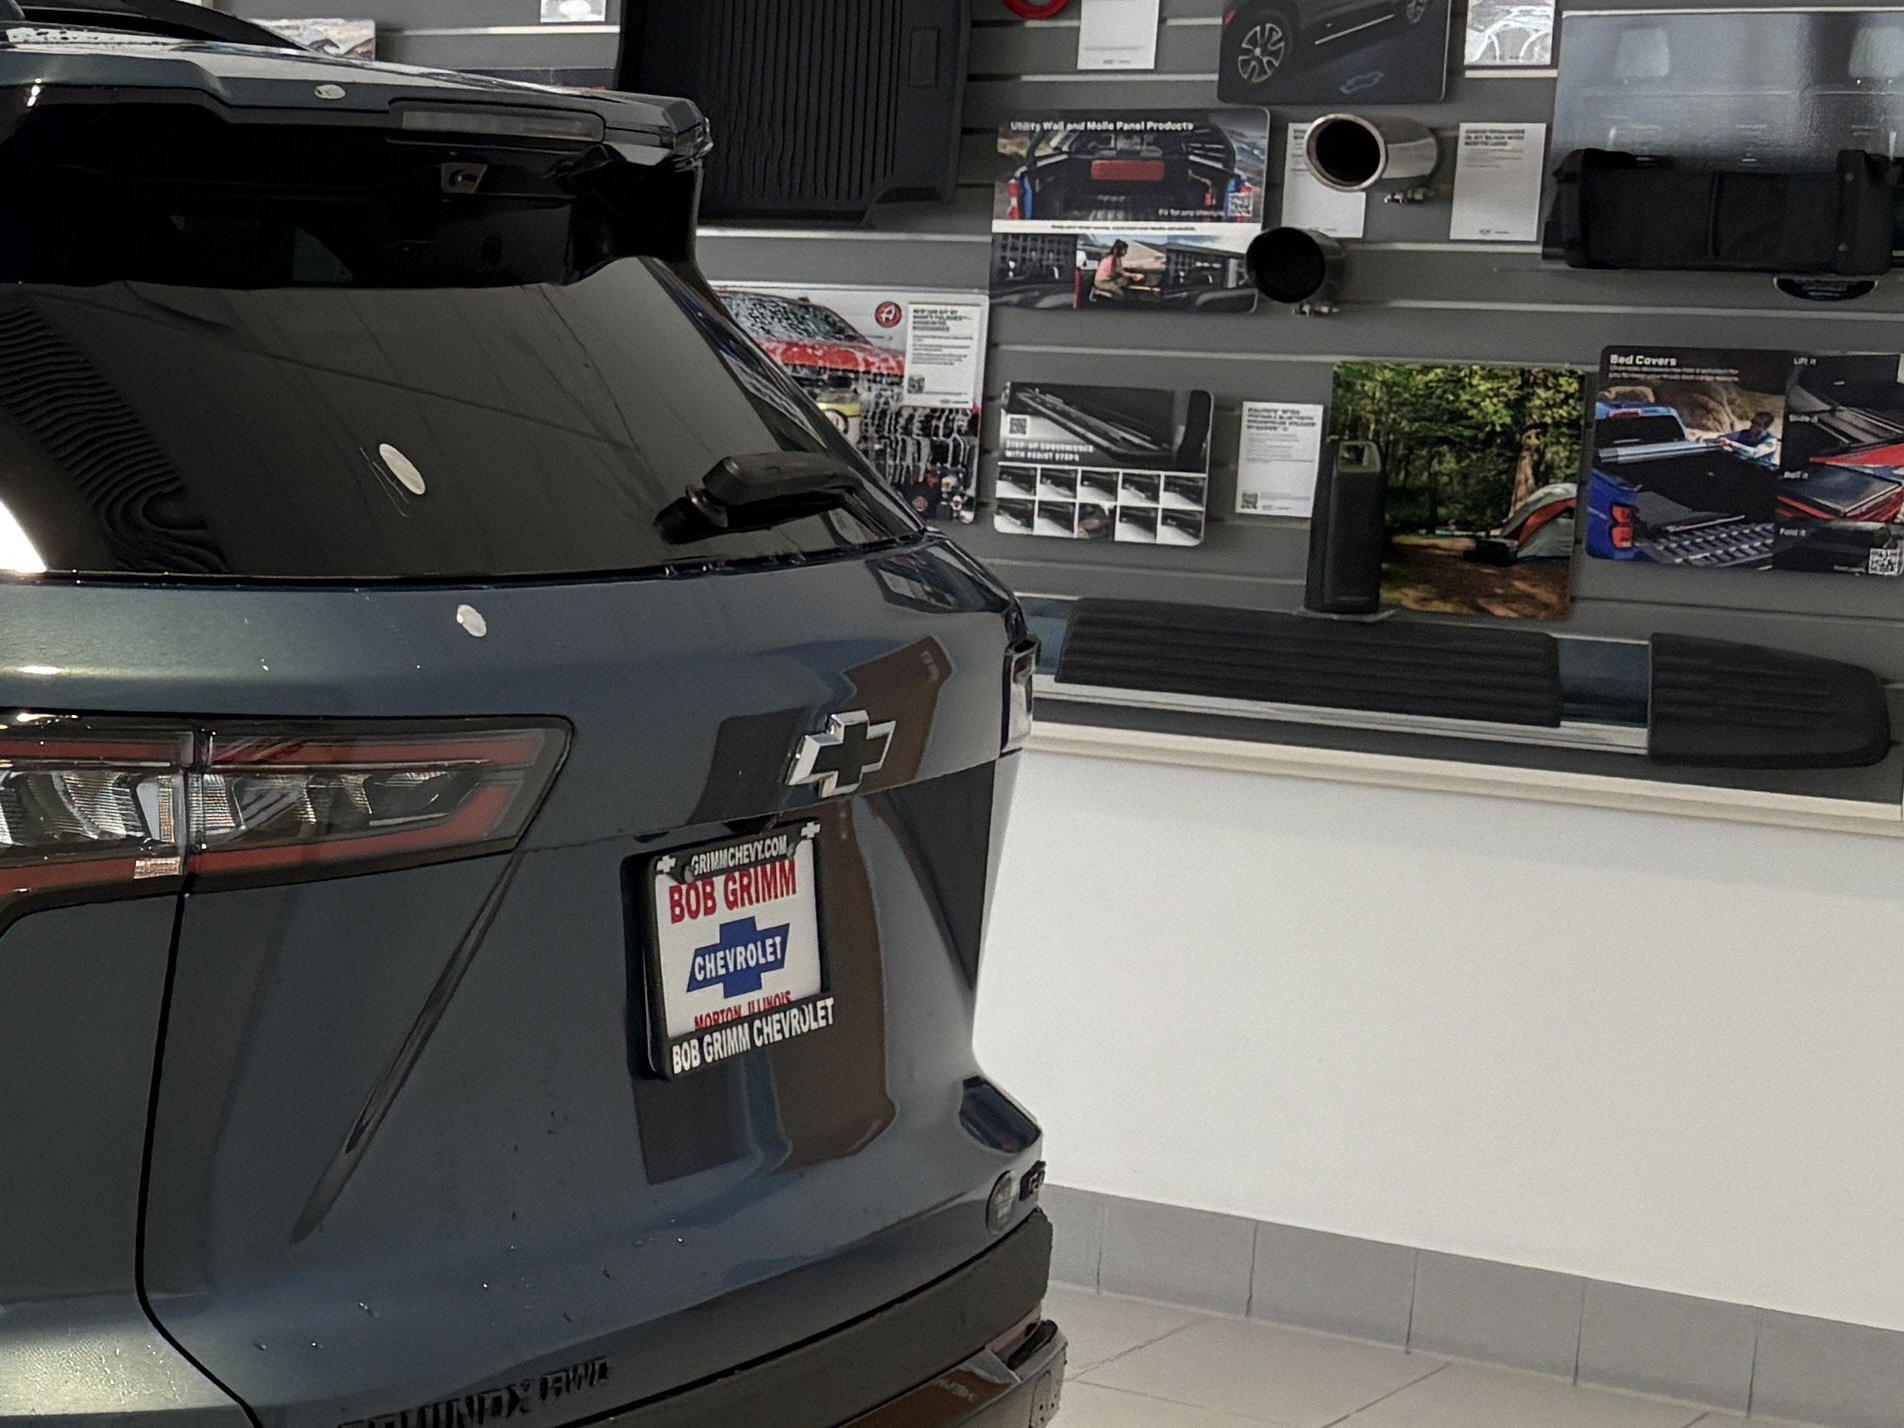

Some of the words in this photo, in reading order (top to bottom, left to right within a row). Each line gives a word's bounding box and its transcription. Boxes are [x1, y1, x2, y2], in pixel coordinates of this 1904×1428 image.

[1010, 121, 1040, 133] Utility
[1042, 121, 1064, 131] Wall
[1066, 121, 1085, 131] and
[1087, 120, 1114, 130] Molle
[1116, 121, 1144, 130] Panel
[1147, 121, 1194, 131] Products
[1609, 354, 1633, 365] Bed
[1635, 355, 1677, 367] Covers
[669, 876, 717, 924] BOB
[723, 858, 797, 911] GRIMM
[694, 935, 782, 981] CHEVROLET
[672, 1037, 701, 1075] BOB
[703, 1021, 750, 1064] GRIMM
[753, 997, 835, 1048] CHEVROLET
